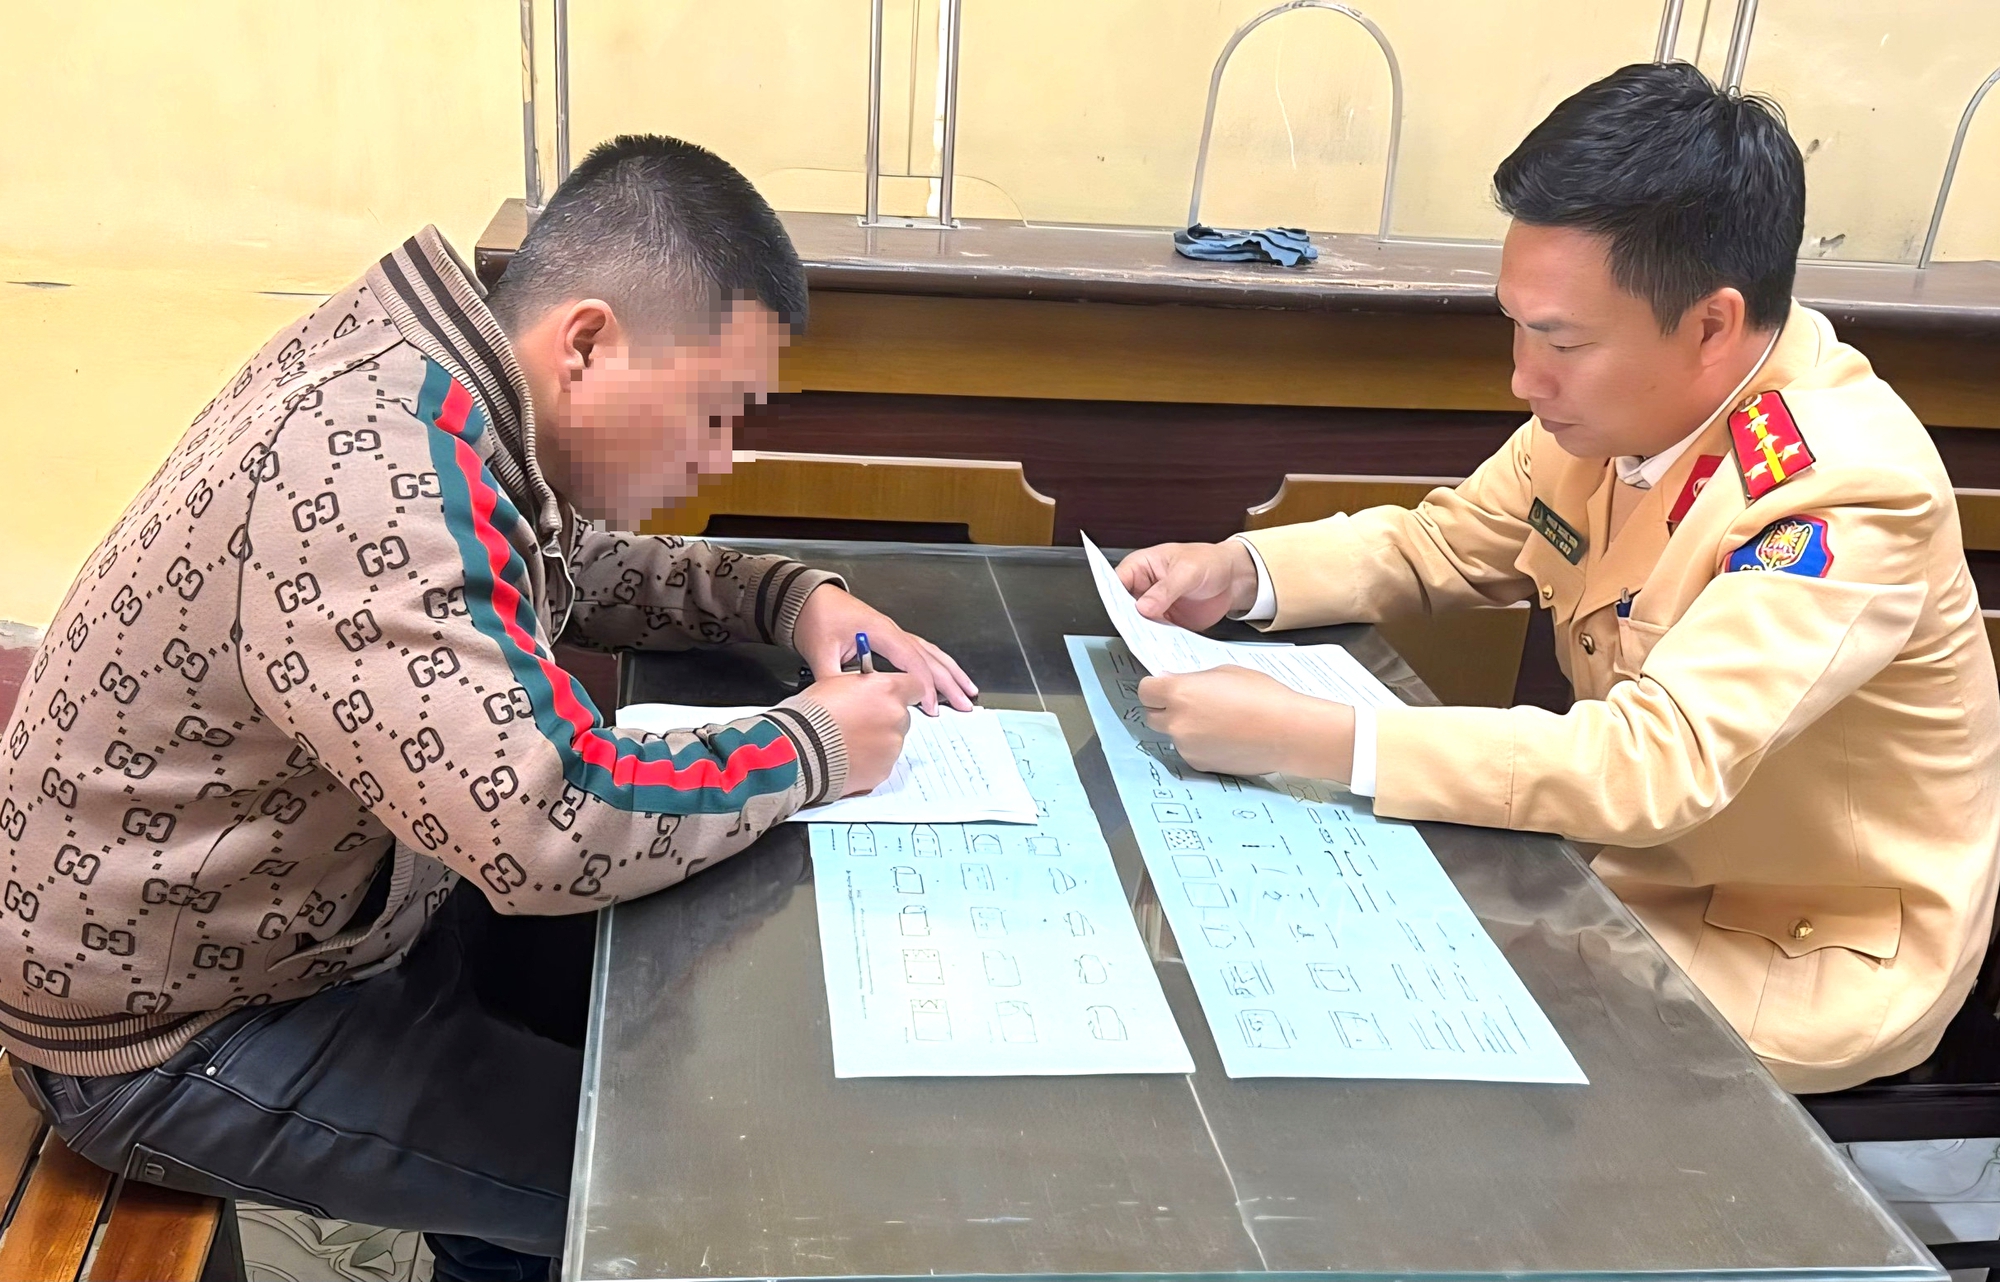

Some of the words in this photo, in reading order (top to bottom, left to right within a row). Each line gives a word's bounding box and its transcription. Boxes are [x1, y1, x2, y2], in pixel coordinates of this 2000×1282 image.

[328, 429, 381, 456] GG
[292, 491, 340, 532] GG
[357, 536, 410, 577] GG
[166, 556, 204, 601] GG
[275, 572, 321, 613] GG
[335, 609, 382, 652] GG
[163, 638, 209, 683] GG
[267, 651, 309, 693] GG
[408, 647, 461, 688] GG
[100, 661, 141, 704] GG
[333, 689, 374, 733] GG
[104, 740, 158, 779] GG
[400, 727, 444, 773] GG
[41, 767, 78, 809] GG
[470, 765, 519, 812] GG
[122, 807, 177, 843] GG
[54, 844, 100, 886] GG
[480, 853, 527, 894] GG
[4, 880, 40, 923] GG
[81, 922, 136, 957] GG
[23, 959, 71, 999] GG
